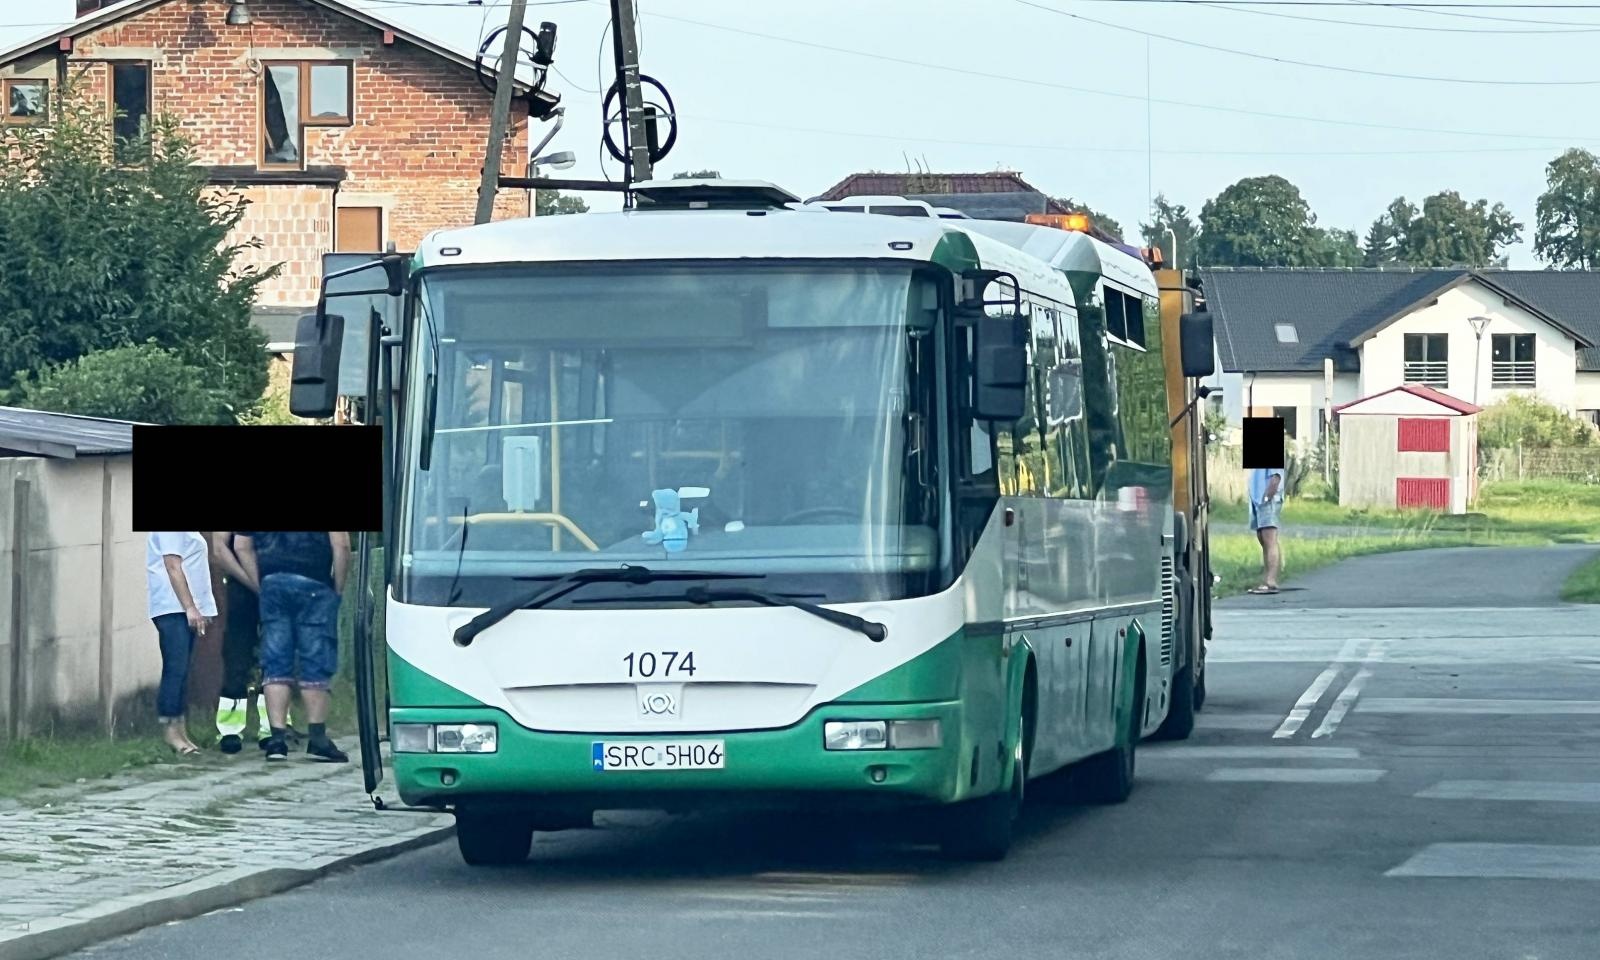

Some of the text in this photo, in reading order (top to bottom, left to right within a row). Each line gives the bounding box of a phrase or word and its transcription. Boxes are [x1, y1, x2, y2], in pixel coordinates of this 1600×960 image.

[623, 651, 696, 677] 1074
[607, 744, 721, 767] SRC 5H06
